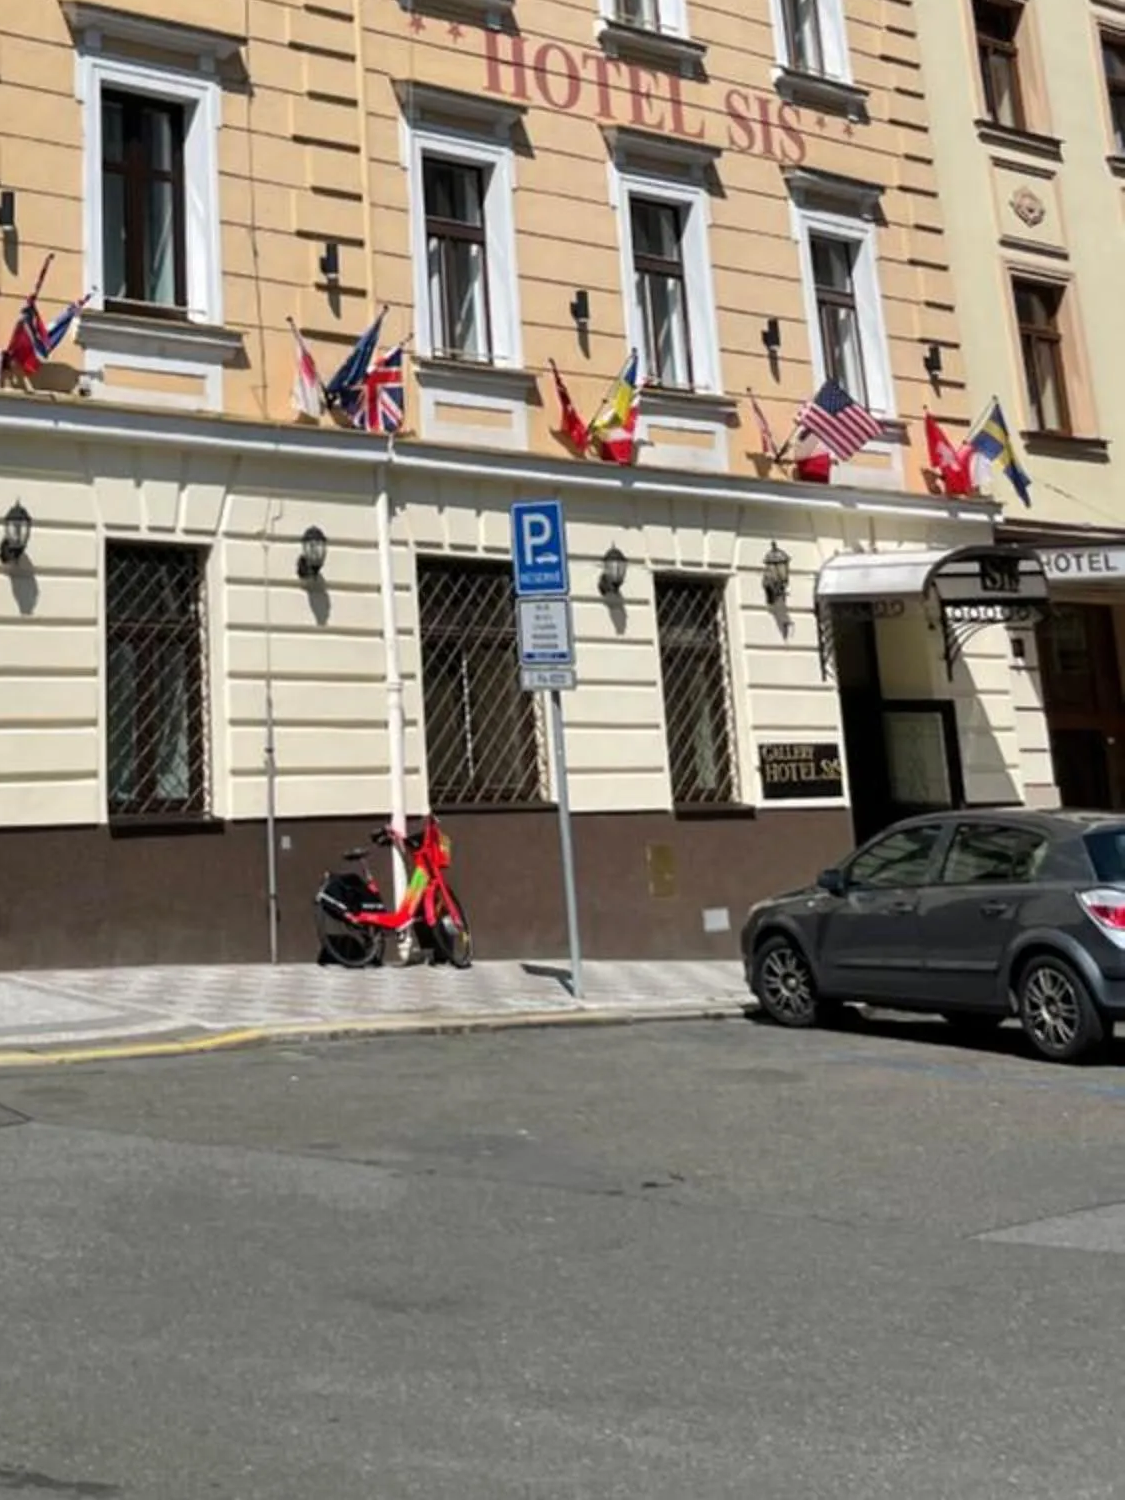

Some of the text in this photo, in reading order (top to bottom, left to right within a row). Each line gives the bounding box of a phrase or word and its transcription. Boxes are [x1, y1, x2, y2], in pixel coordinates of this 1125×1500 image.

[481, 32, 807, 164] HOTEL SIS
[522, 512, 552, 566] P
[766, 762, 816, 782] HOTEL
